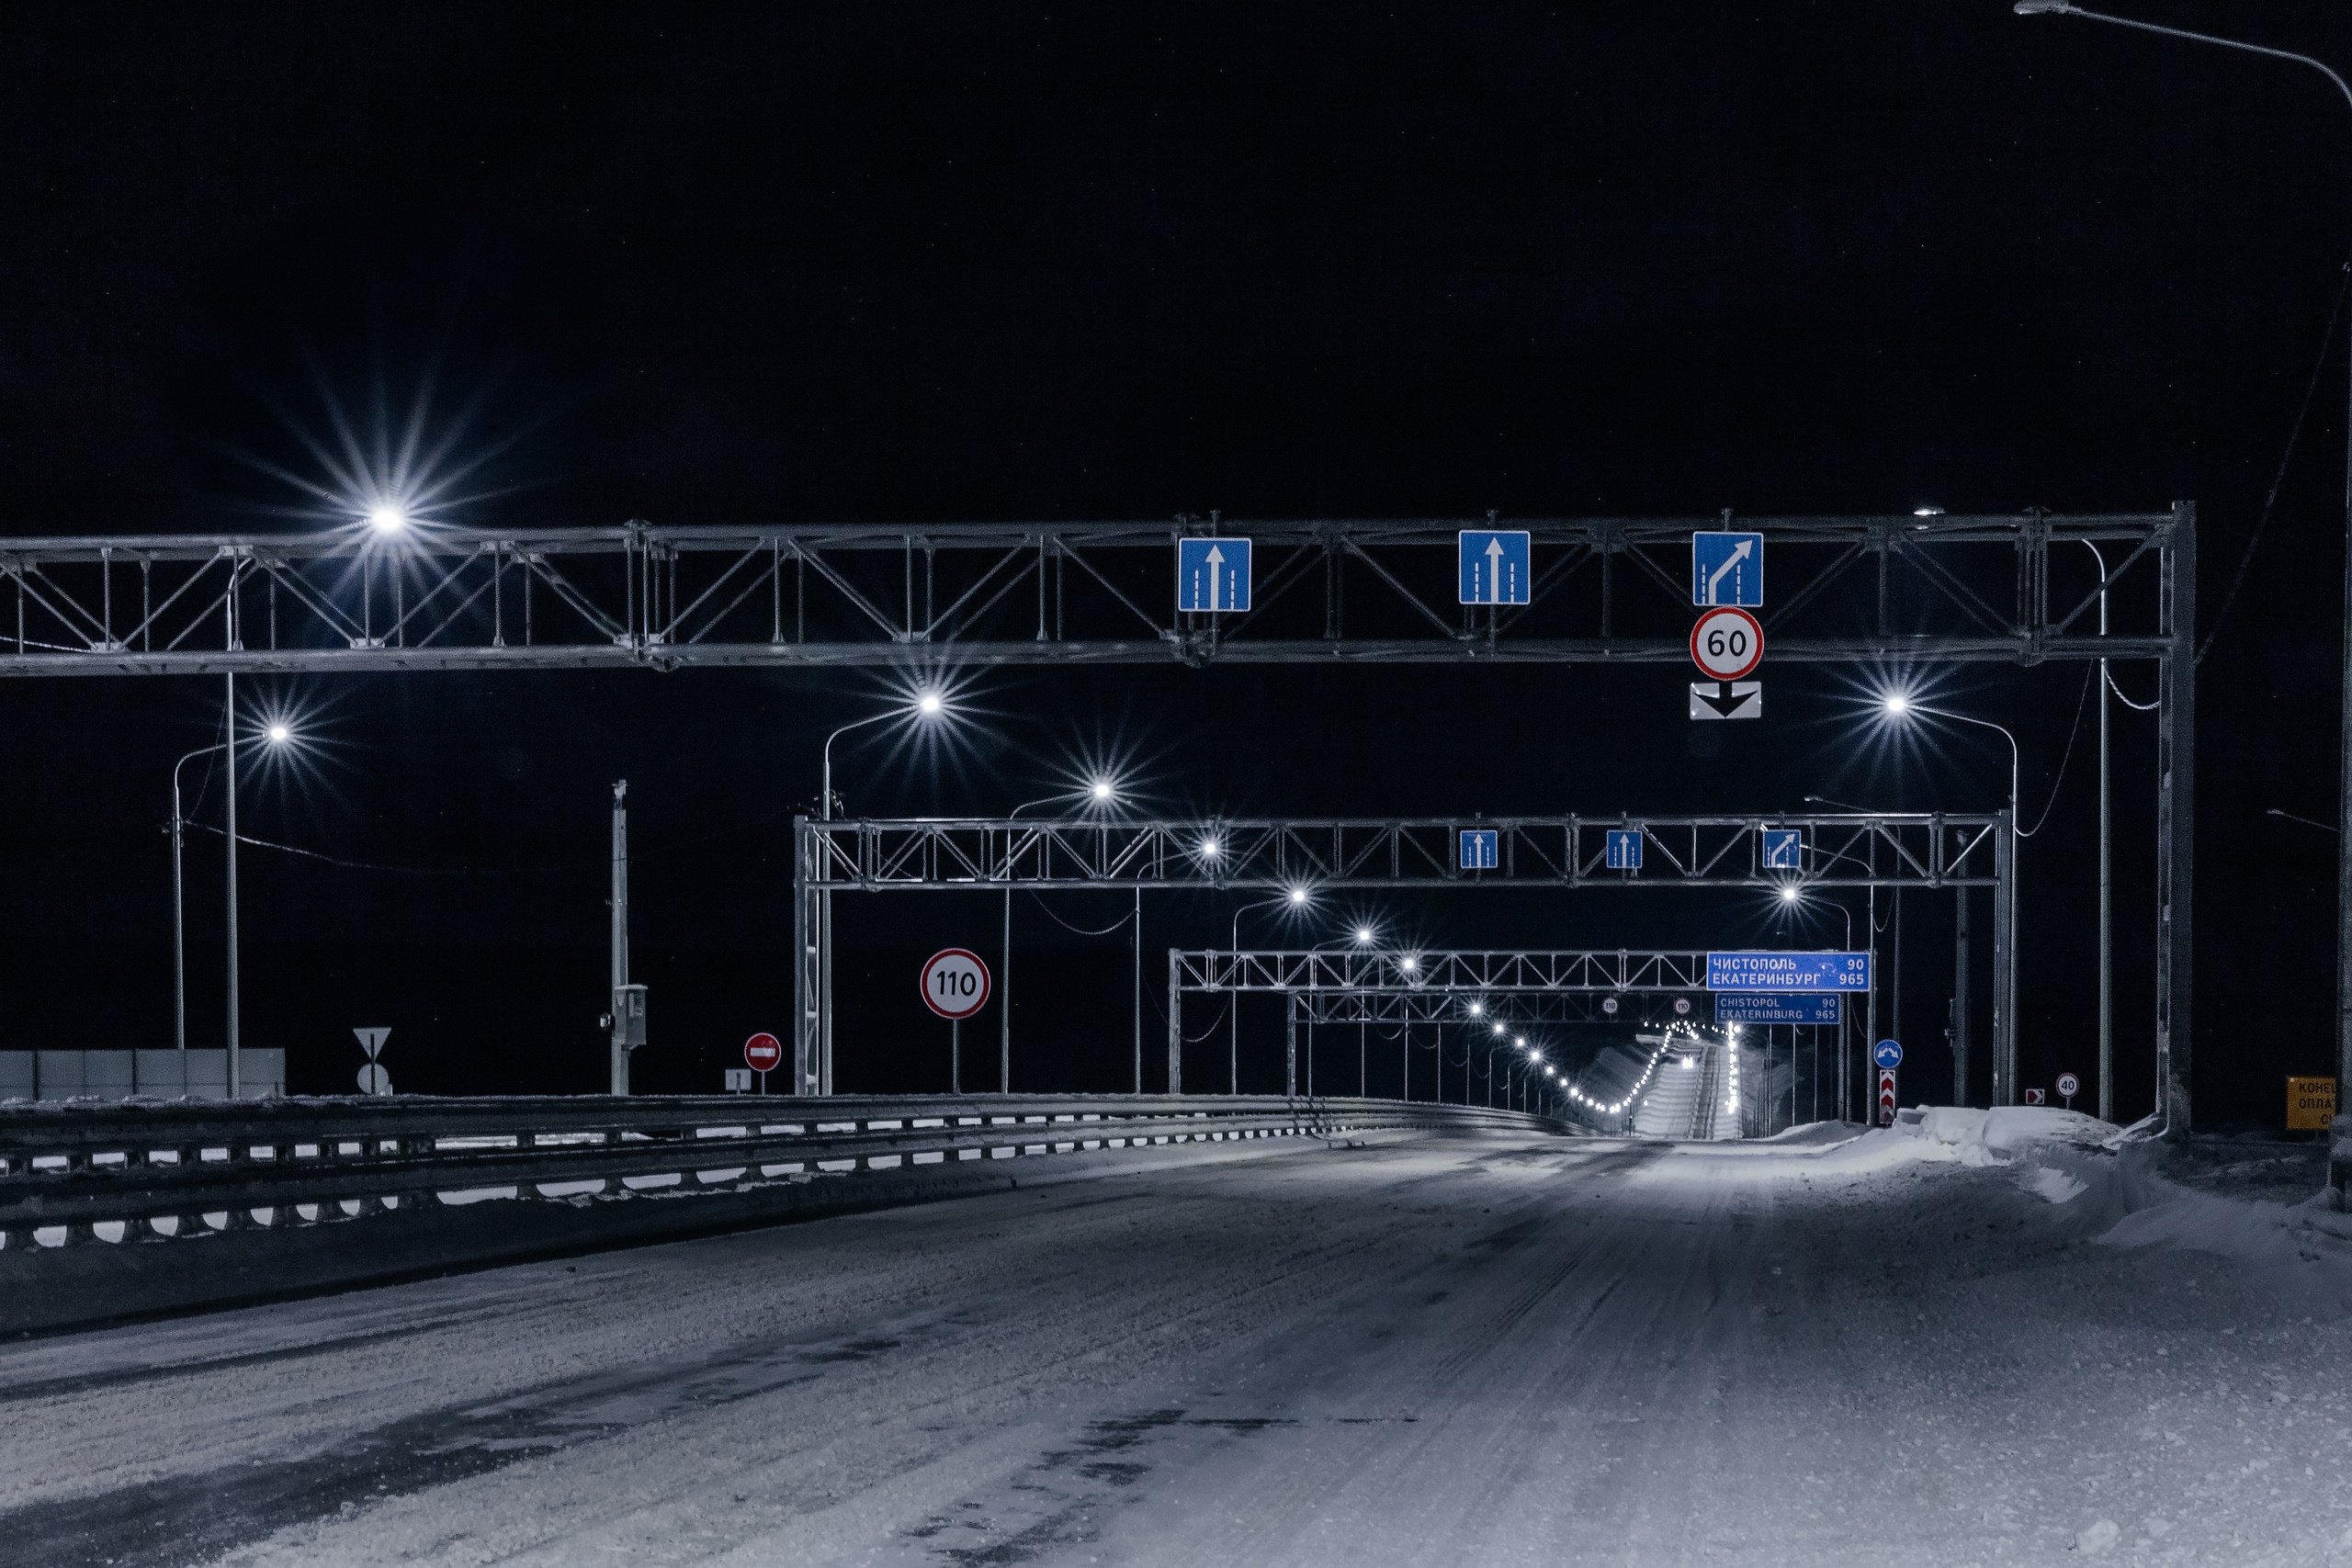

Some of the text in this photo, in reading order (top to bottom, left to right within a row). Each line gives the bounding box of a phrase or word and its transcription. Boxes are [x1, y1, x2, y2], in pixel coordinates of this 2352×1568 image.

[1708, 630, 1747, 657] 60
[1713, 957, 1865, 971] ЧИСТОПОЛЬ 90
[937, 971, 977, 997] 110
[1713, 973, 1865, 986] ЕКАТЕРИНБУРГ 965
[1719, 998, 1836, 1009] CHISTOPOL 90
[1719, 1010, 1836, 1021] EKATERINBURG 965
[2061, 1080, 2075, 1090] 40
[2299, 1098, 2335, 1109] ОПЛА
